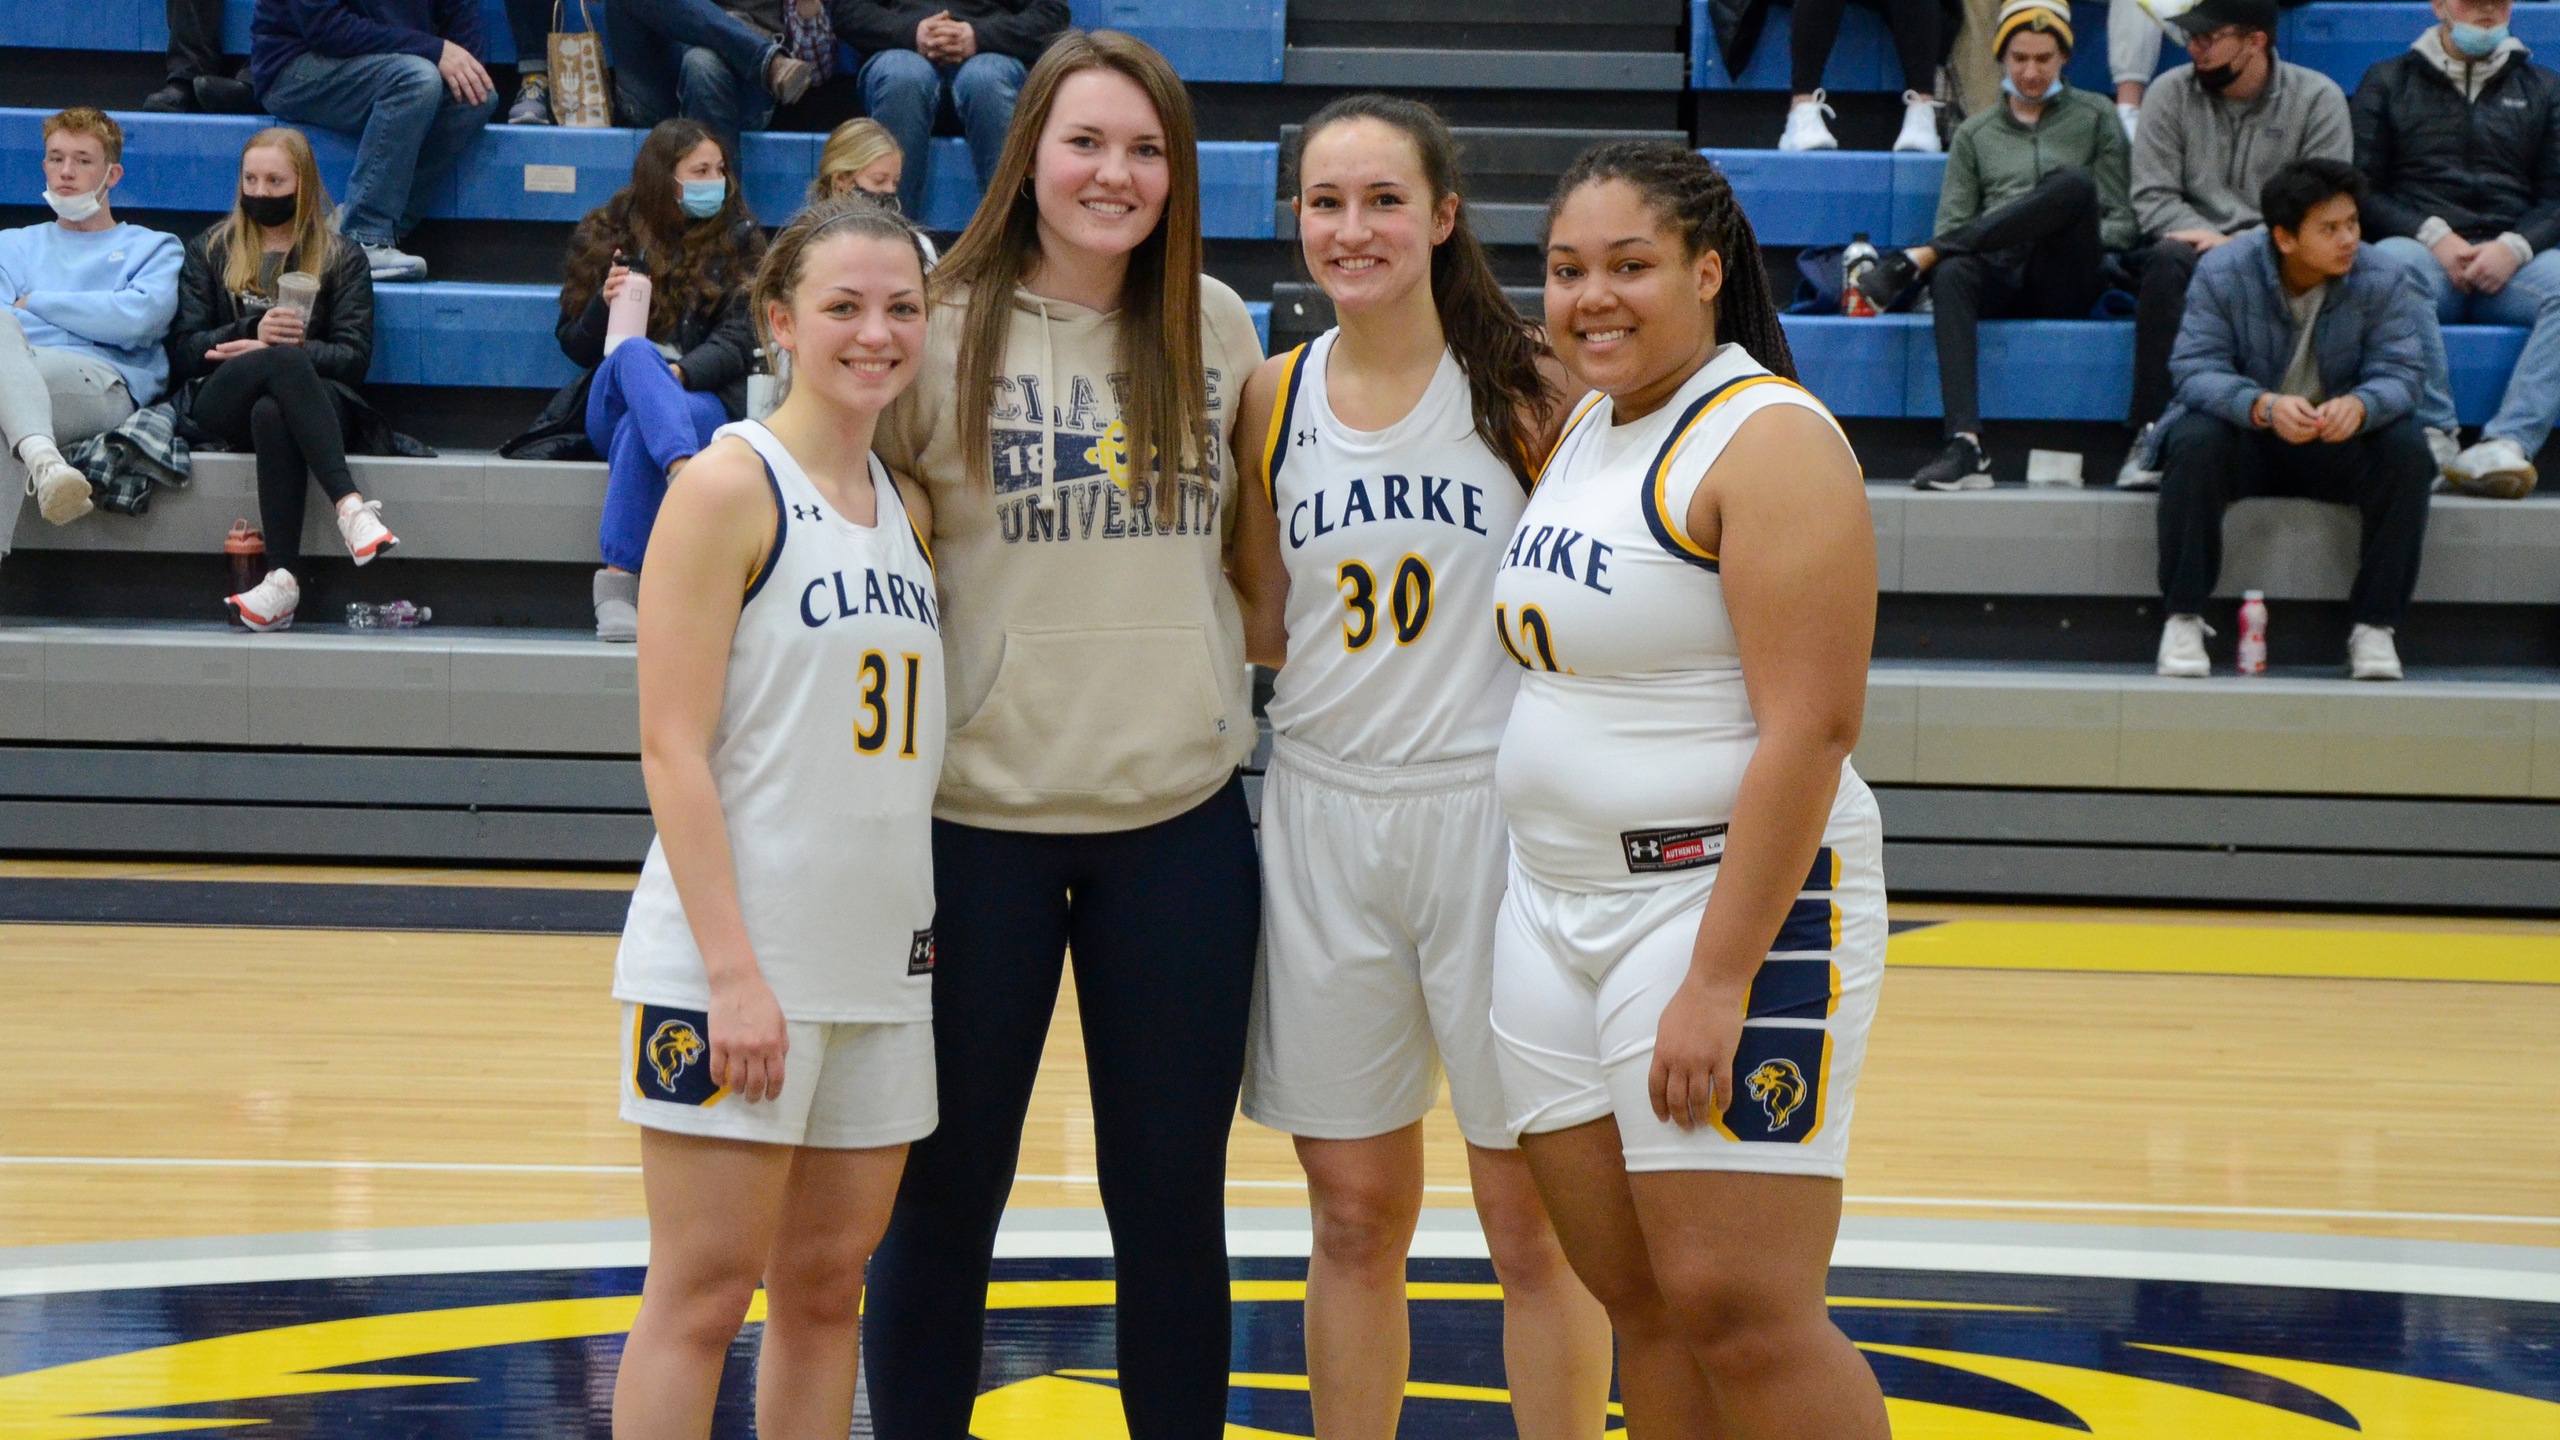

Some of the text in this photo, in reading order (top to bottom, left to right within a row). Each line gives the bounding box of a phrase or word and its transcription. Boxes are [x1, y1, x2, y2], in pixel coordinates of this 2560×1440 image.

[990, 367, 1221, 430] CLAE
[1289, 474, 1487, 549] CLARKE
[1497, 524, 1613, 596] ARKE
[1337, 552, 1434, 653] 30
[854, 649, 921, 759] 31
[1665, 844, 1702, 859] AUTHENTIC
